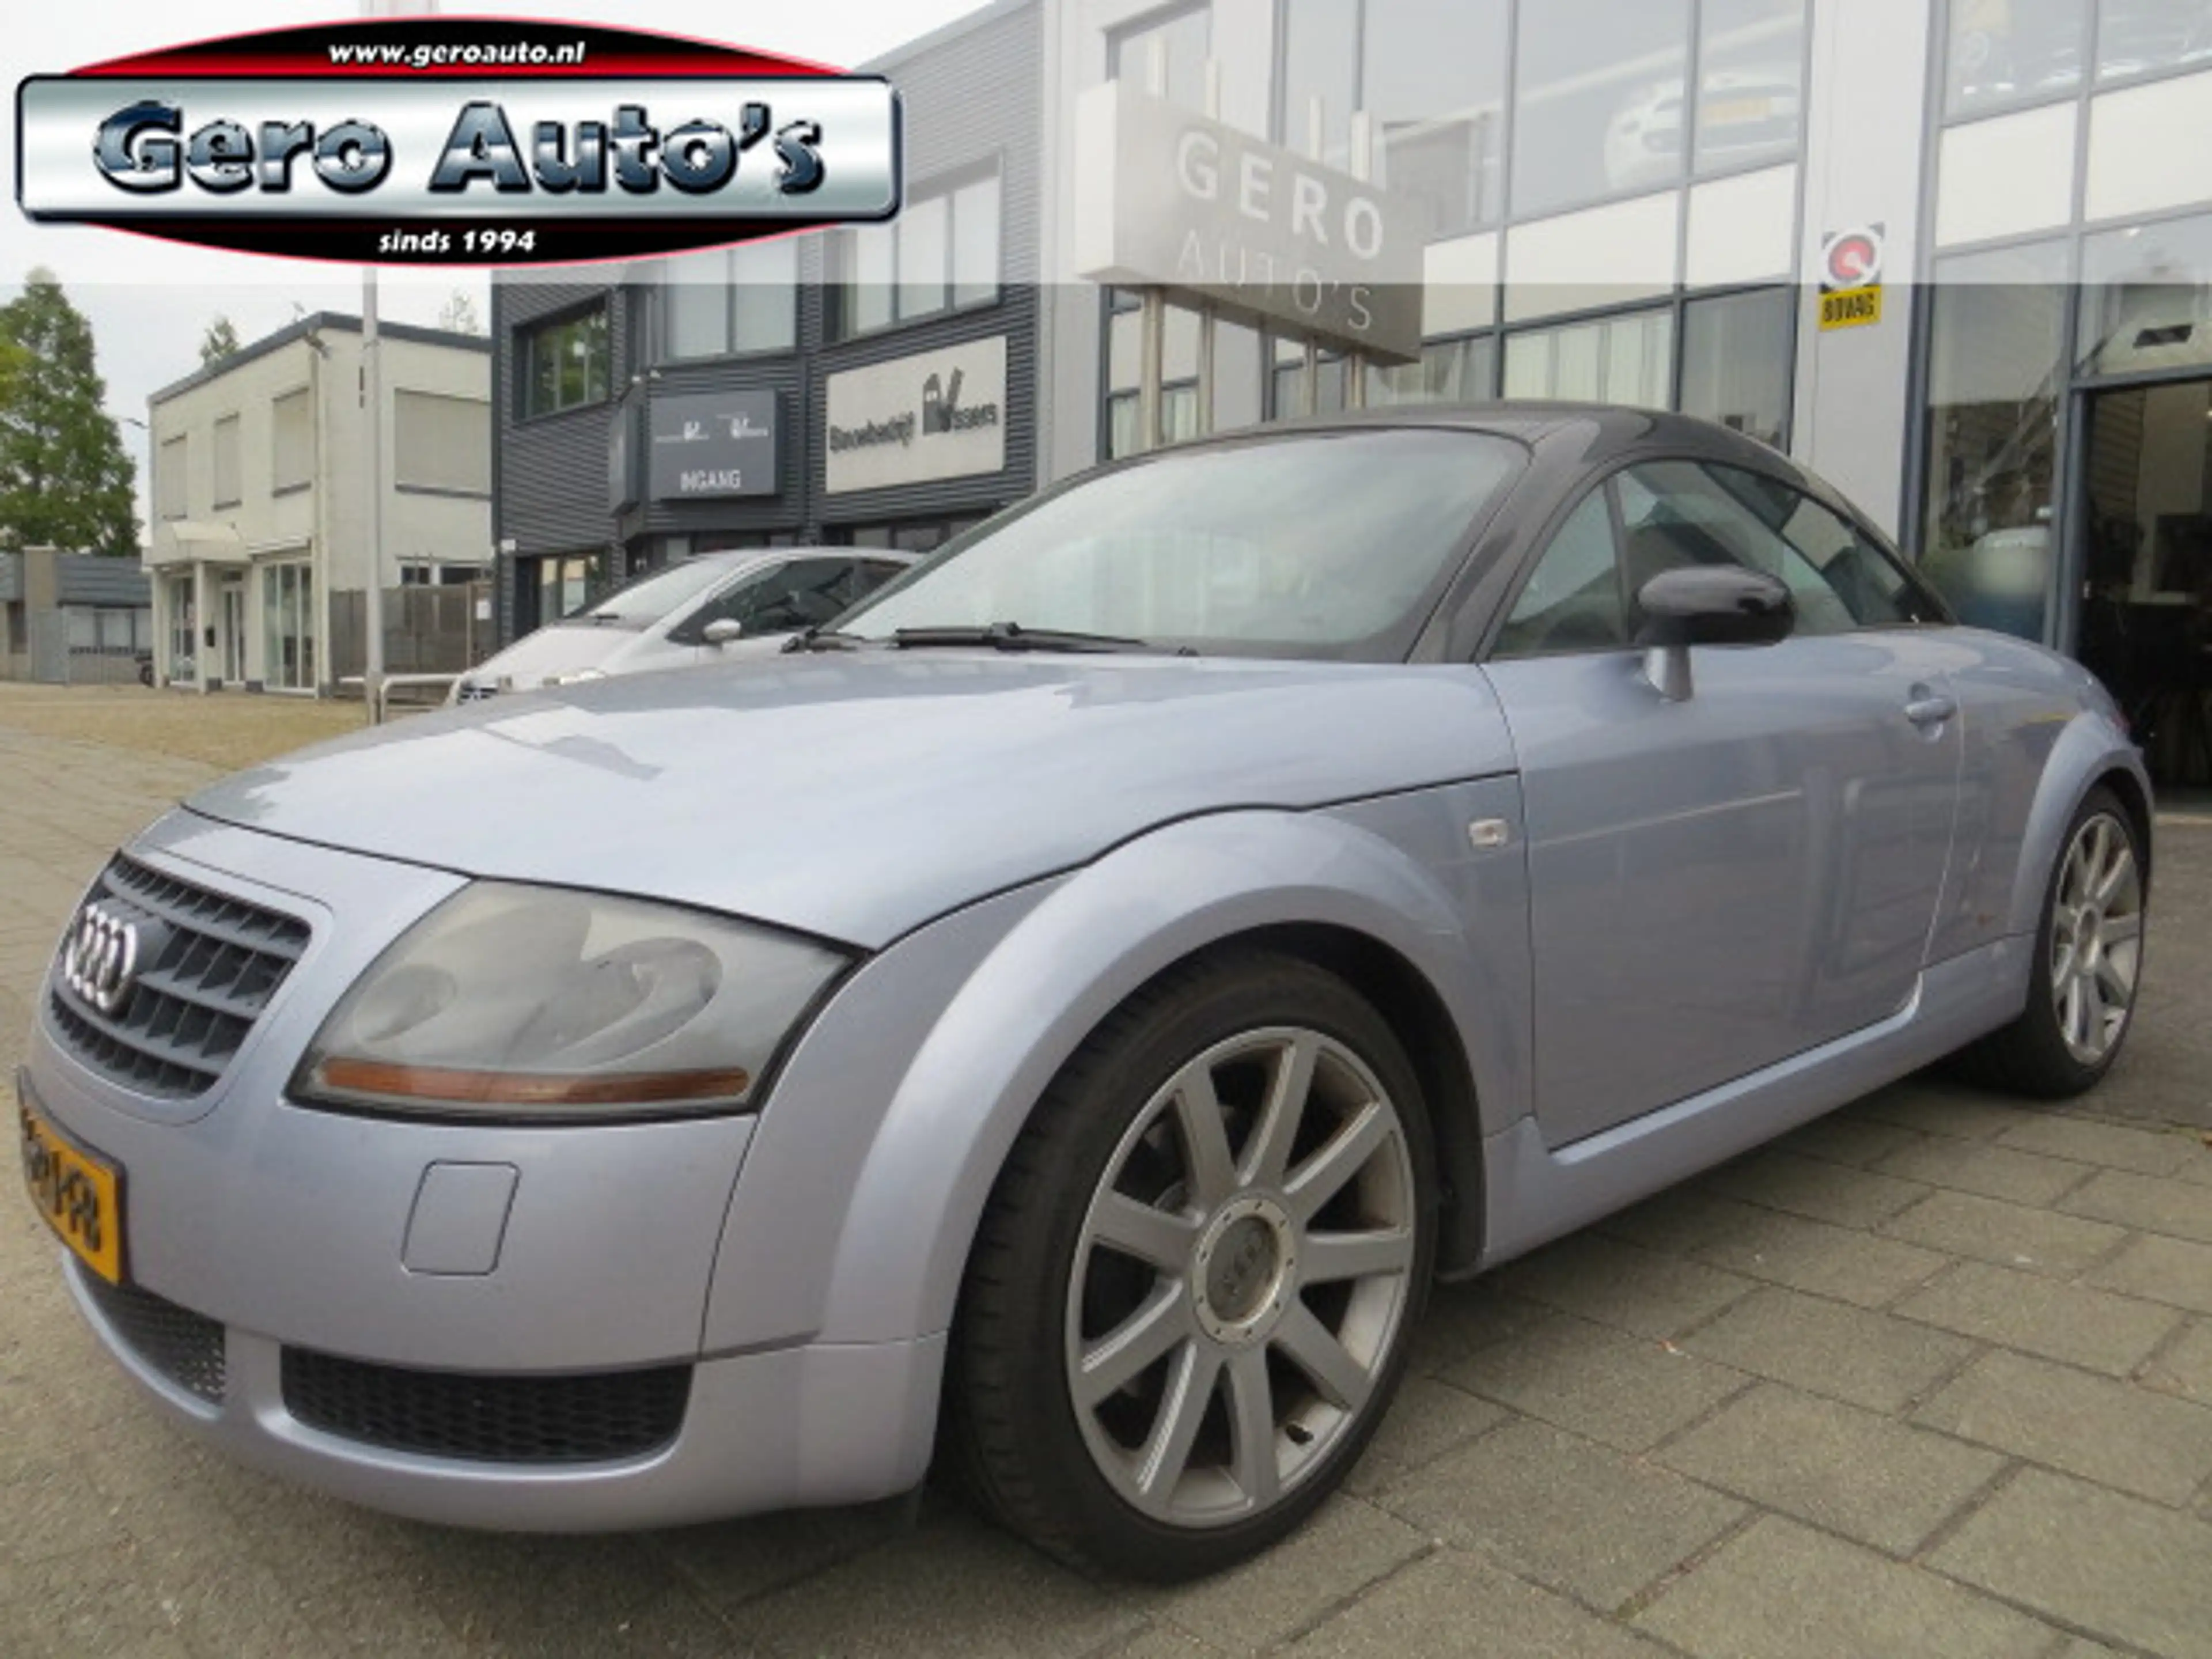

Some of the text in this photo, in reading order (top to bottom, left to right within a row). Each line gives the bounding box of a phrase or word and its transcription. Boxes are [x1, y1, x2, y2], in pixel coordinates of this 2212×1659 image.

[1176, 130, 1382, 260] GERO
[1177, 229, 1373, 331] AUTO'S
[680, 469, 741, 492] INGANG
